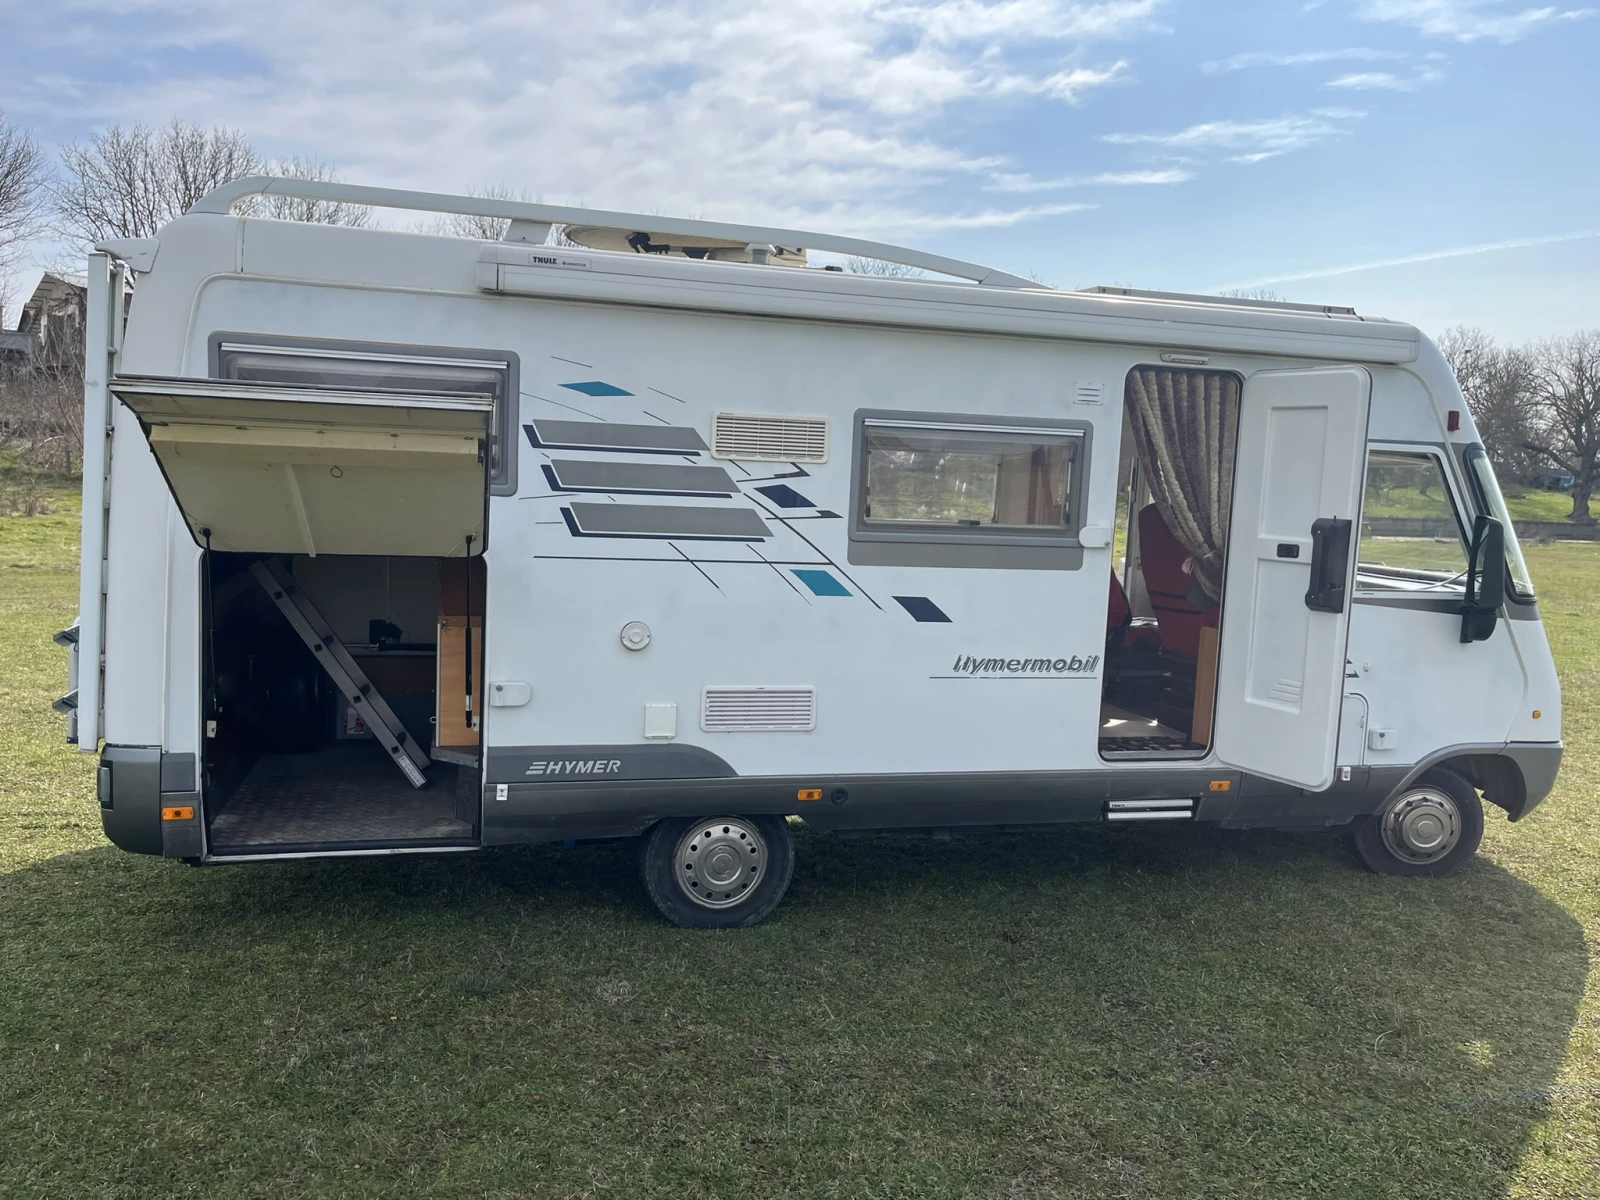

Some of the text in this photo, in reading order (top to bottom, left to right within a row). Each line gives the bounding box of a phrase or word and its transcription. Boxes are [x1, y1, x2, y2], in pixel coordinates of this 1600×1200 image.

[533, 256, 557, 265] THULE
[953, 654, 1100, 675] Hymermobil
[544, 759, 621, 775] HYMER
